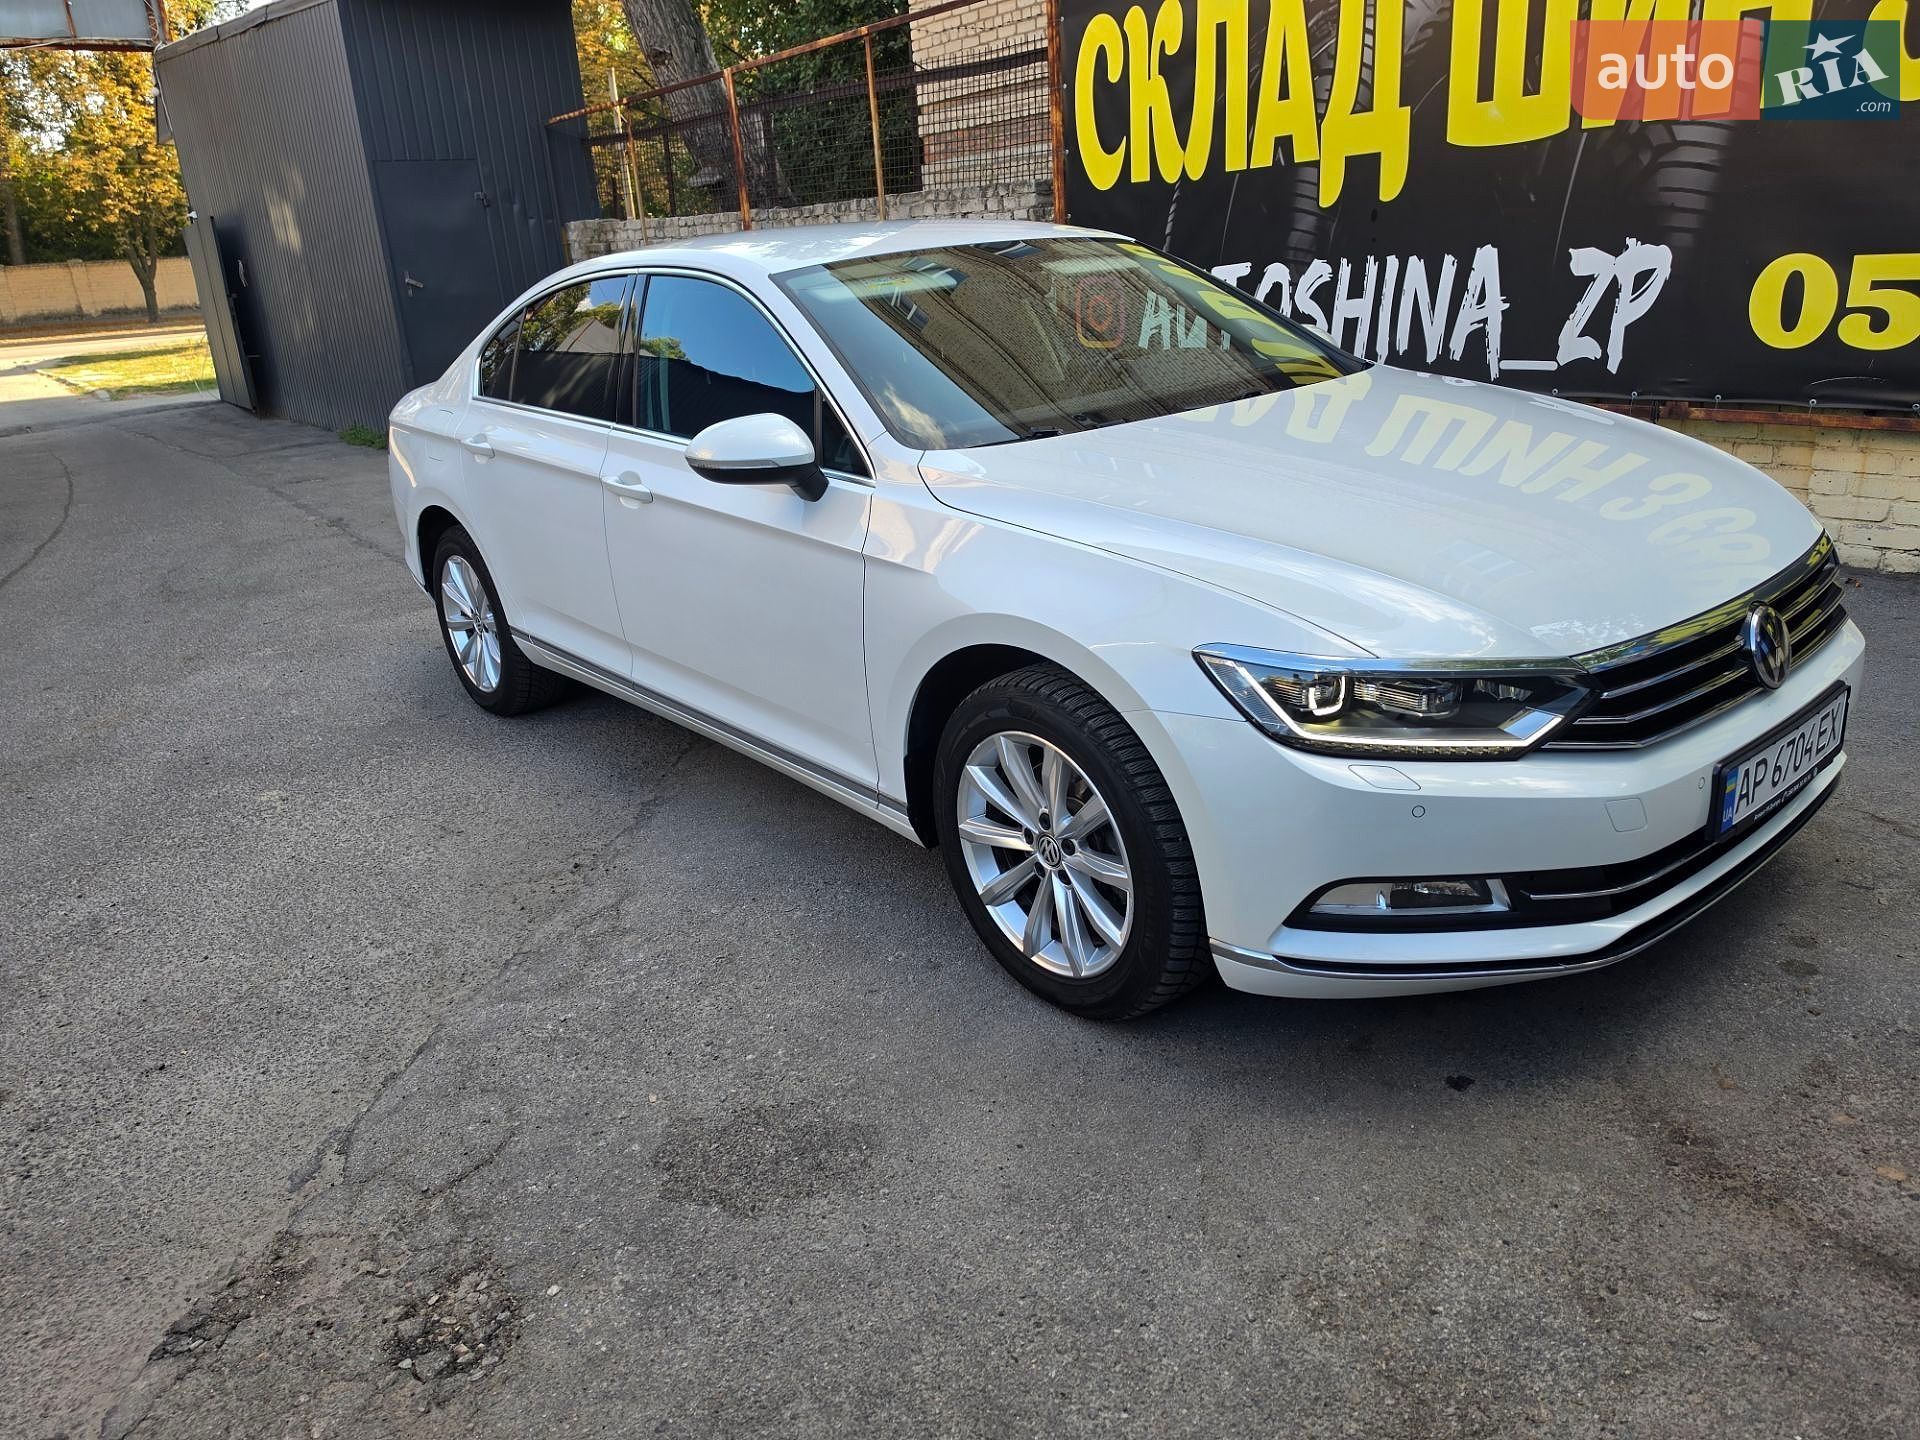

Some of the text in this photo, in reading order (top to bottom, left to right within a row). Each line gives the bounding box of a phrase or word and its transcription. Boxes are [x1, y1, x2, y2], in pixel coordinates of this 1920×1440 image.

[1075, 0, 1411, 208] СКЛАД
[1749, 252, 1920, 351] 05
[1735, 757, 1768, 815] AP
[1771, 722, 1817, 788] 6704
[1815, 702, 1842, 757] EX
[1723, 807, 1733, 823] UA
